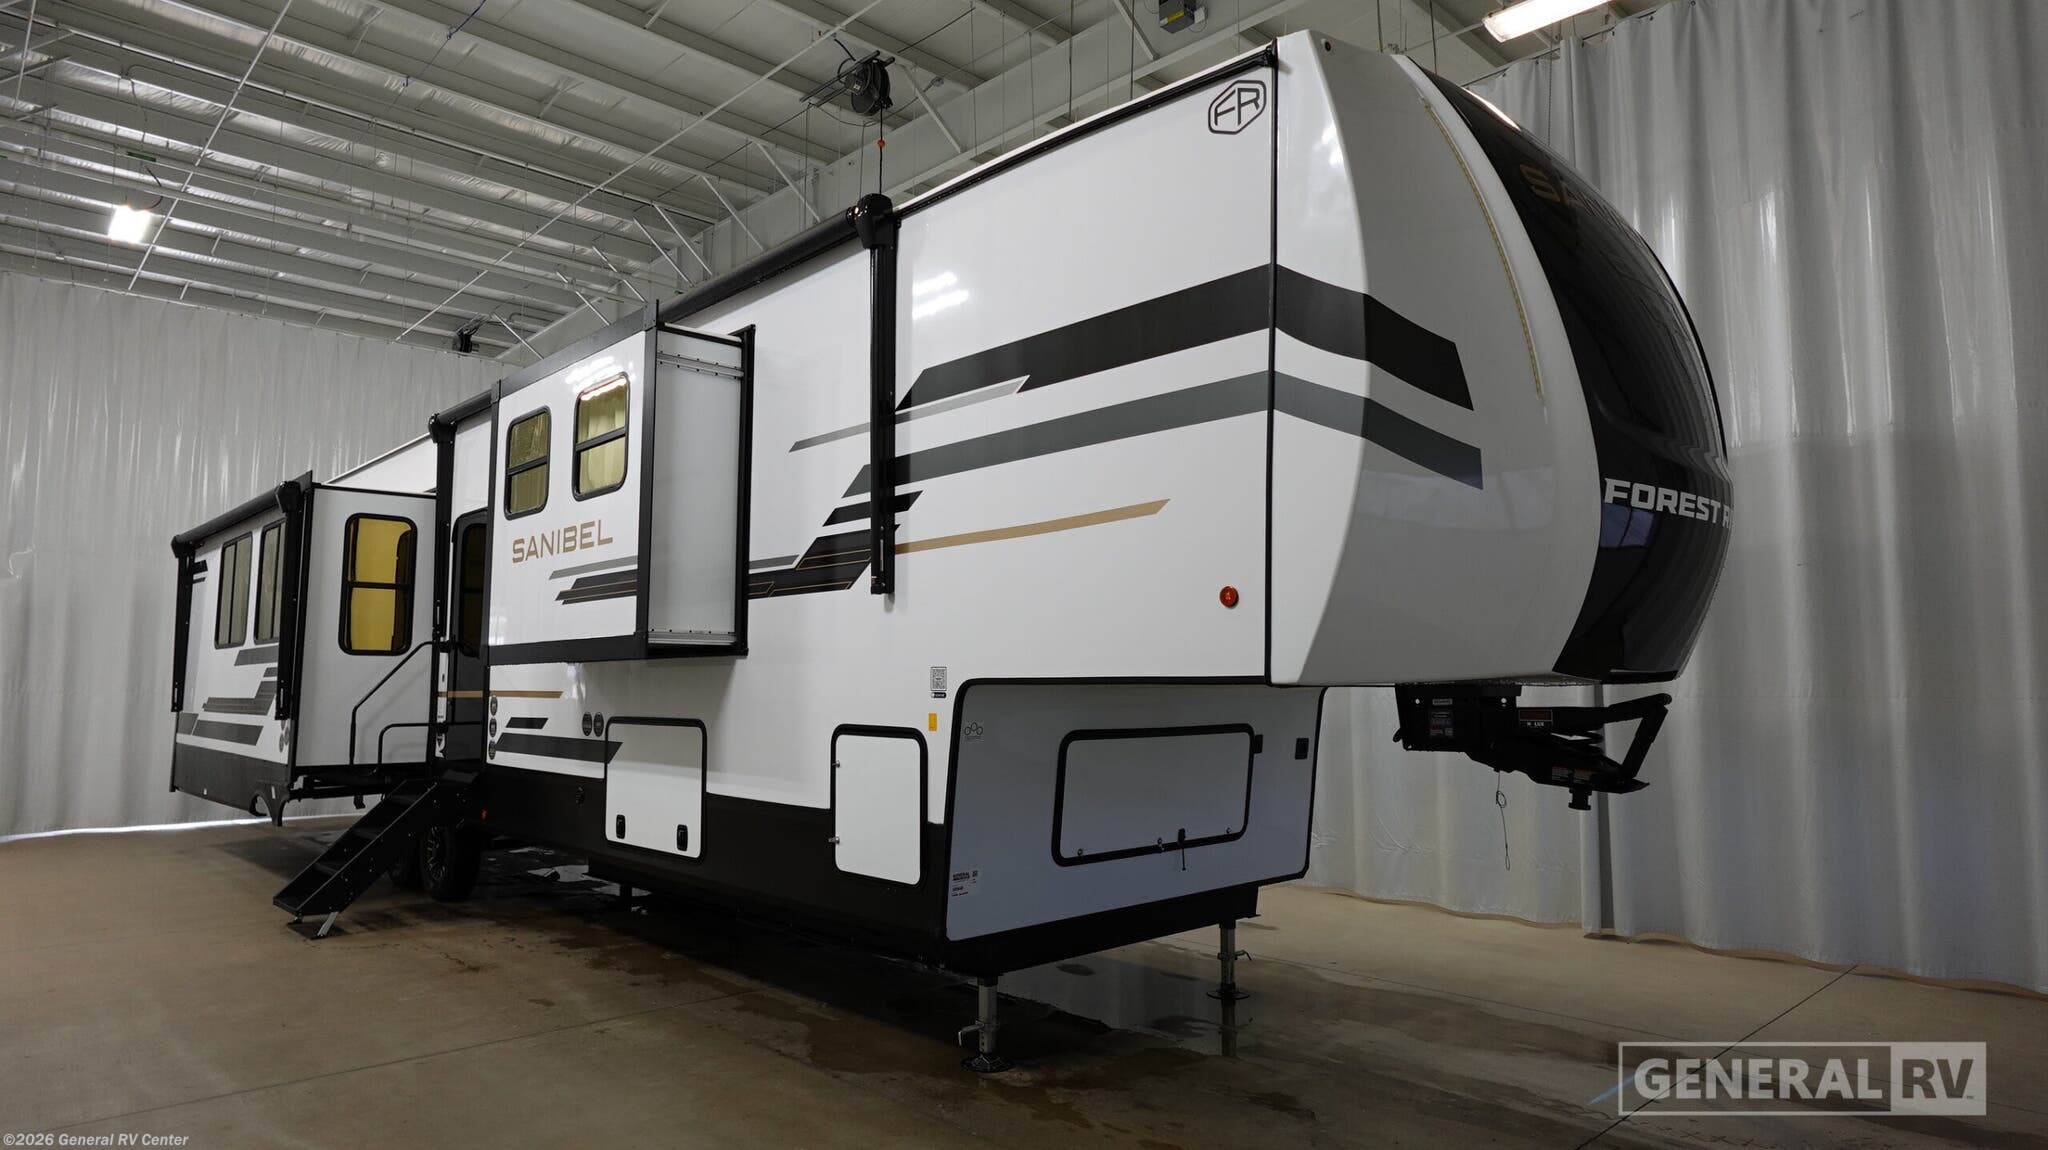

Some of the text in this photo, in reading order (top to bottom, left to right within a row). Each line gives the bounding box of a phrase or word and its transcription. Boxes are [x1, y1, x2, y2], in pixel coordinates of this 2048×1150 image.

[1214, 88, 1260, 126] FR
[1604, 477, 1721, 524] FOREST
[512, 519, 613, 564] SANIBEL
